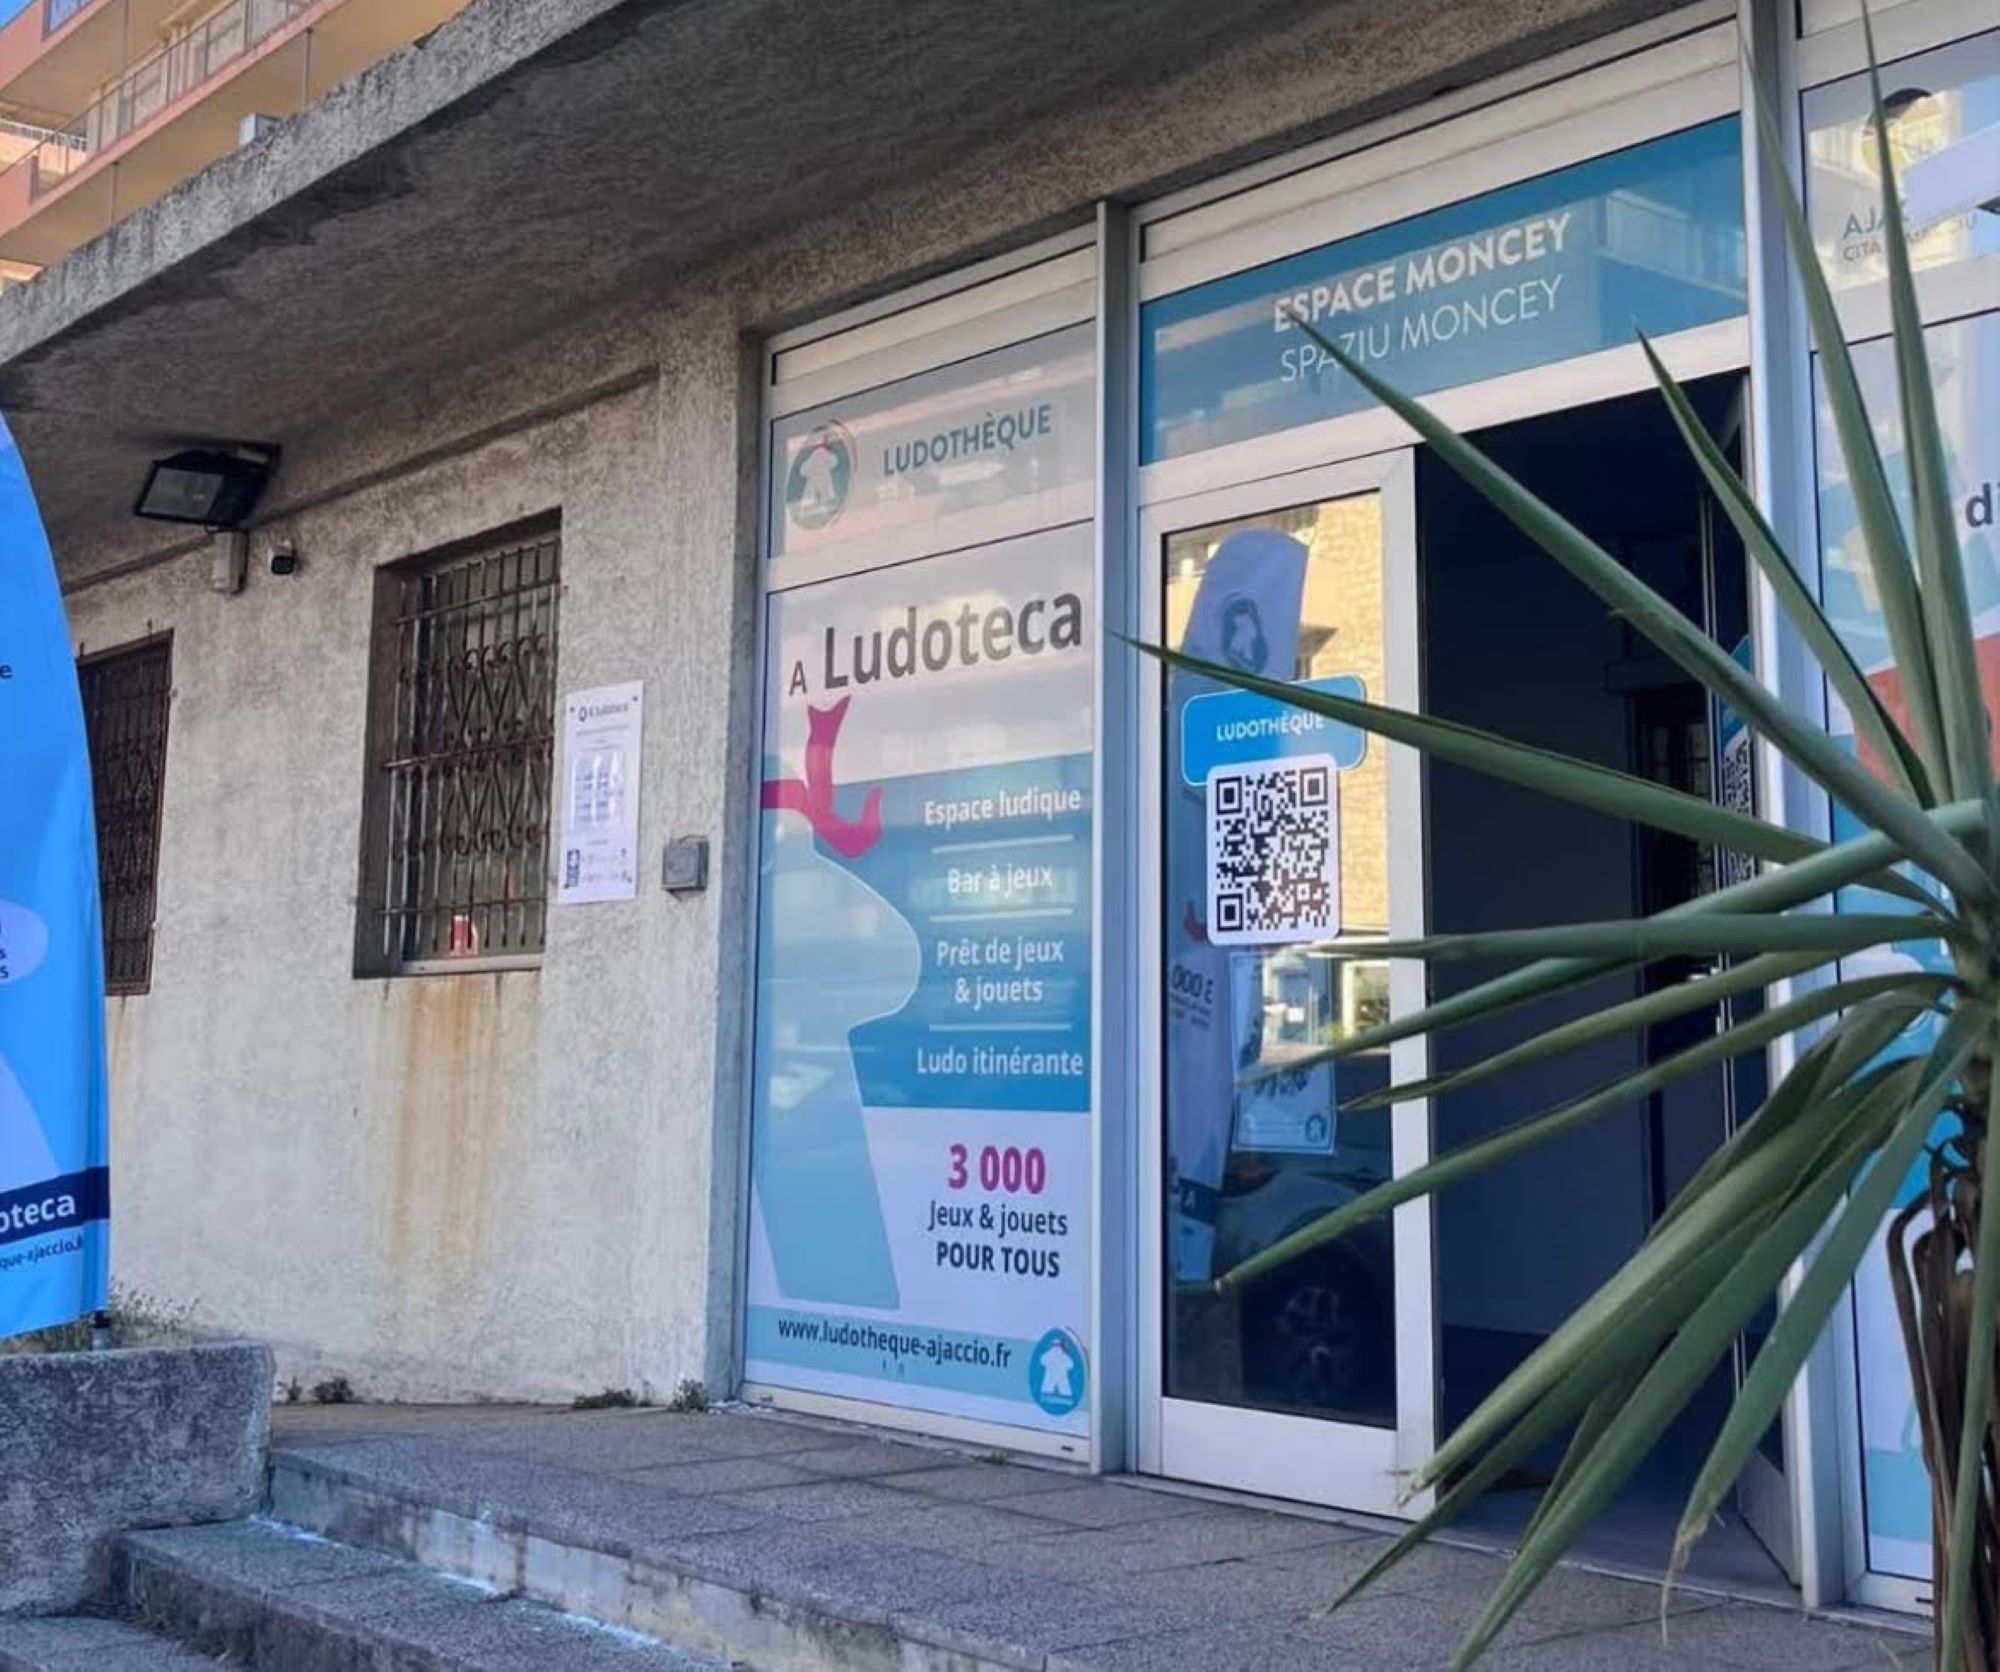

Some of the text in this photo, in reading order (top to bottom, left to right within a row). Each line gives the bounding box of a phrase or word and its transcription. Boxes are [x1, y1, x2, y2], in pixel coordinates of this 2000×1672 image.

[1274, 212, 1570, 333] ESPACE MONCEY
[1400, 274, 1563, 352] MONCEY
[883, 403, 1052, 476] LUDOTHÈQUE
[788, 592, 1083, 696] A Ludoteca
[924, 783, 1082, 831] Espace ludique
[948, 863, 1053, 899] Bar à jeux
[937, 935, 1064, 971] Prêt de jeux
[955, 975, 1043, 1011] & jouets
[916, 1046, 1084, 1077] Ludo itinérante
[948, 1144, 1046, 1195] 3 000
[927, 1199, 1068, 1239] Jeux & jouets
[937, 1240, 1060, 1278] POUR TOUS
[778, 1318, 1012, 1369] www.ludotheque-ajaccio.fr
